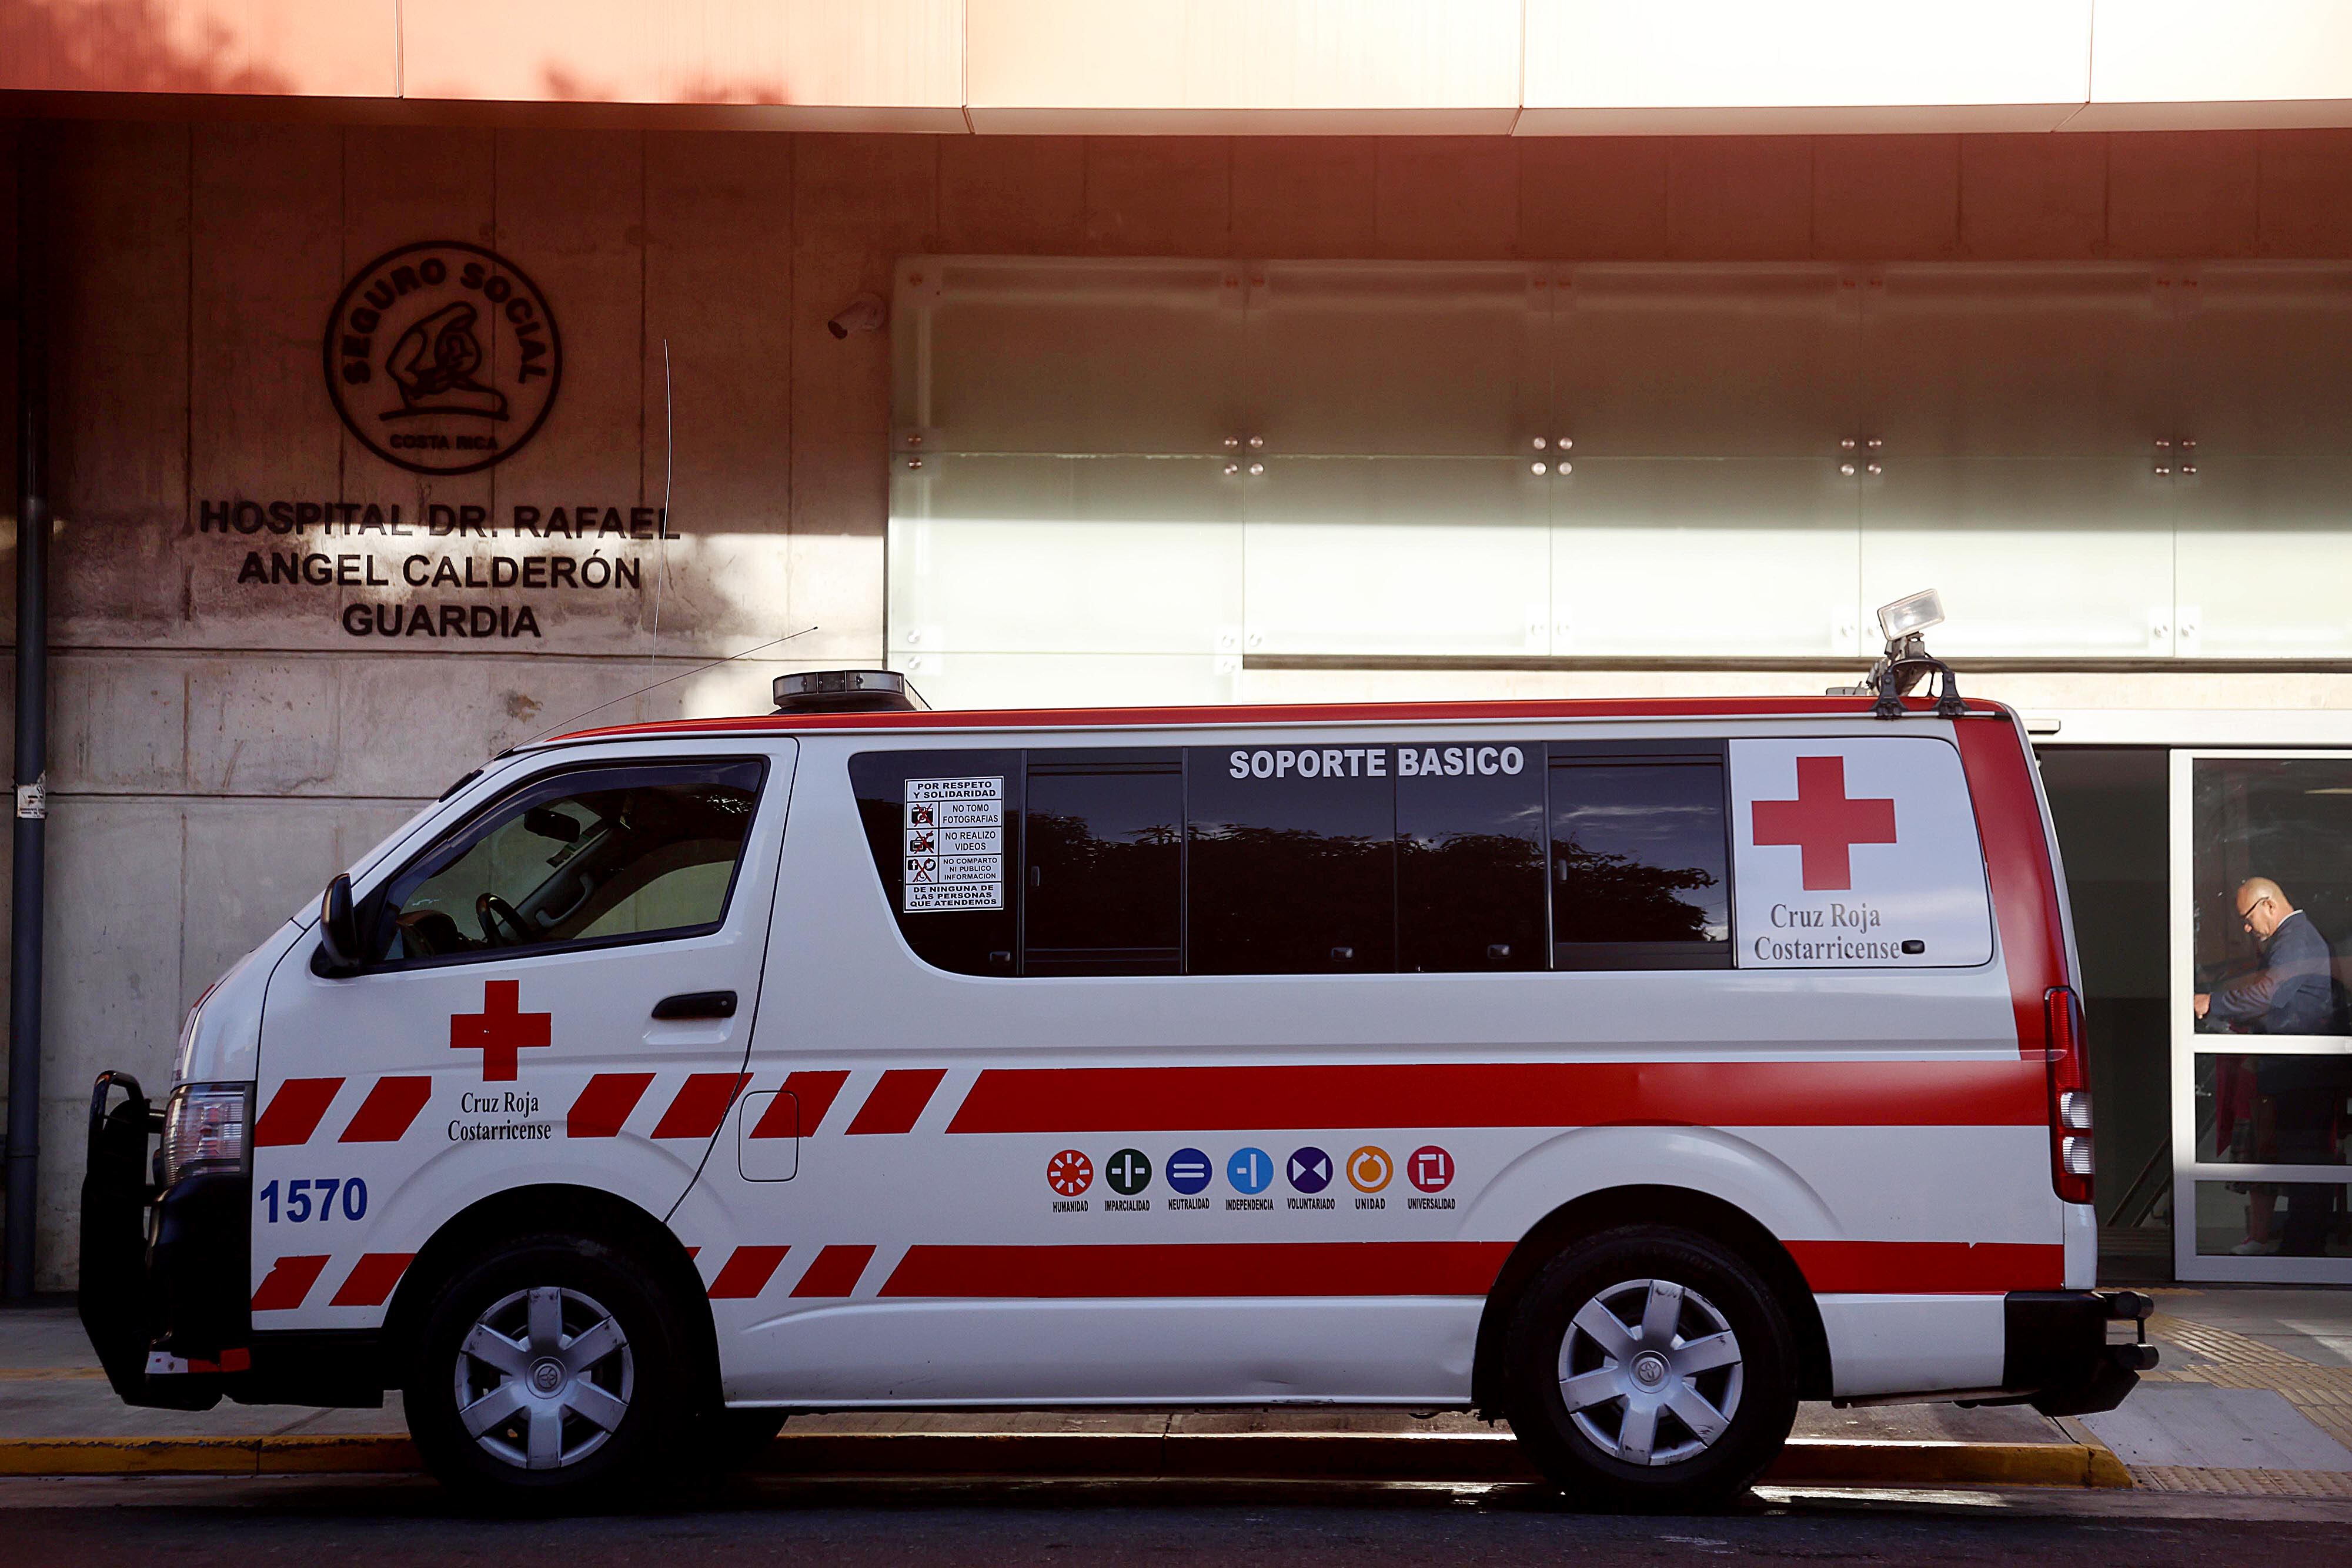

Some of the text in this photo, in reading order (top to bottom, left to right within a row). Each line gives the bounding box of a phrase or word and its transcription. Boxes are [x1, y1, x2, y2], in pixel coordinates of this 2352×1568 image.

[343, 258, 546, 385] SEGURO SOCIAL
[390, 434, 497, 450] COSTA RICA
[200, 500, 681, 539] HOSPITAL DR. RAFAEL
[237, 549, 640, 588] ANGEL CALDERÓN
[343, 603, 541, 637] GUARDIA
[1230, 747, 1524, 778] SOPORTE BASICO
[924, 790, 995, 798] SOLIDARIDAD
[943, 815, 998, 824] FOTOGRAFIAS
[955, 842, 985, 851] VIDEOS
[1770, 903, 1881, 934] Cruz Roja
[1755, 936, 1900, 960] Costarricense
[461, 1091, 539, 1118] Cruz Roja
[447, 1120, 552, 1141] Costarricense
[260, 1178, 368, 1223] 1570
[1052, 1201, 1088, 1212] HUMANIDAD
[1104, 1199, 1150, 1212] IMPARCIALIDAD
[1168, 1198, 1210, 1211] NEUTRALIDAD
[1225, 1198, 1274, 1211] INDEPENDENCIA
[1287, 1198, 1335, 1210] VOLUNTARIADO
[1355, 1198, 1385, 1210] UNIDAD
[1408, 1197, 1456, 1210] UNIVERSALIDAD
